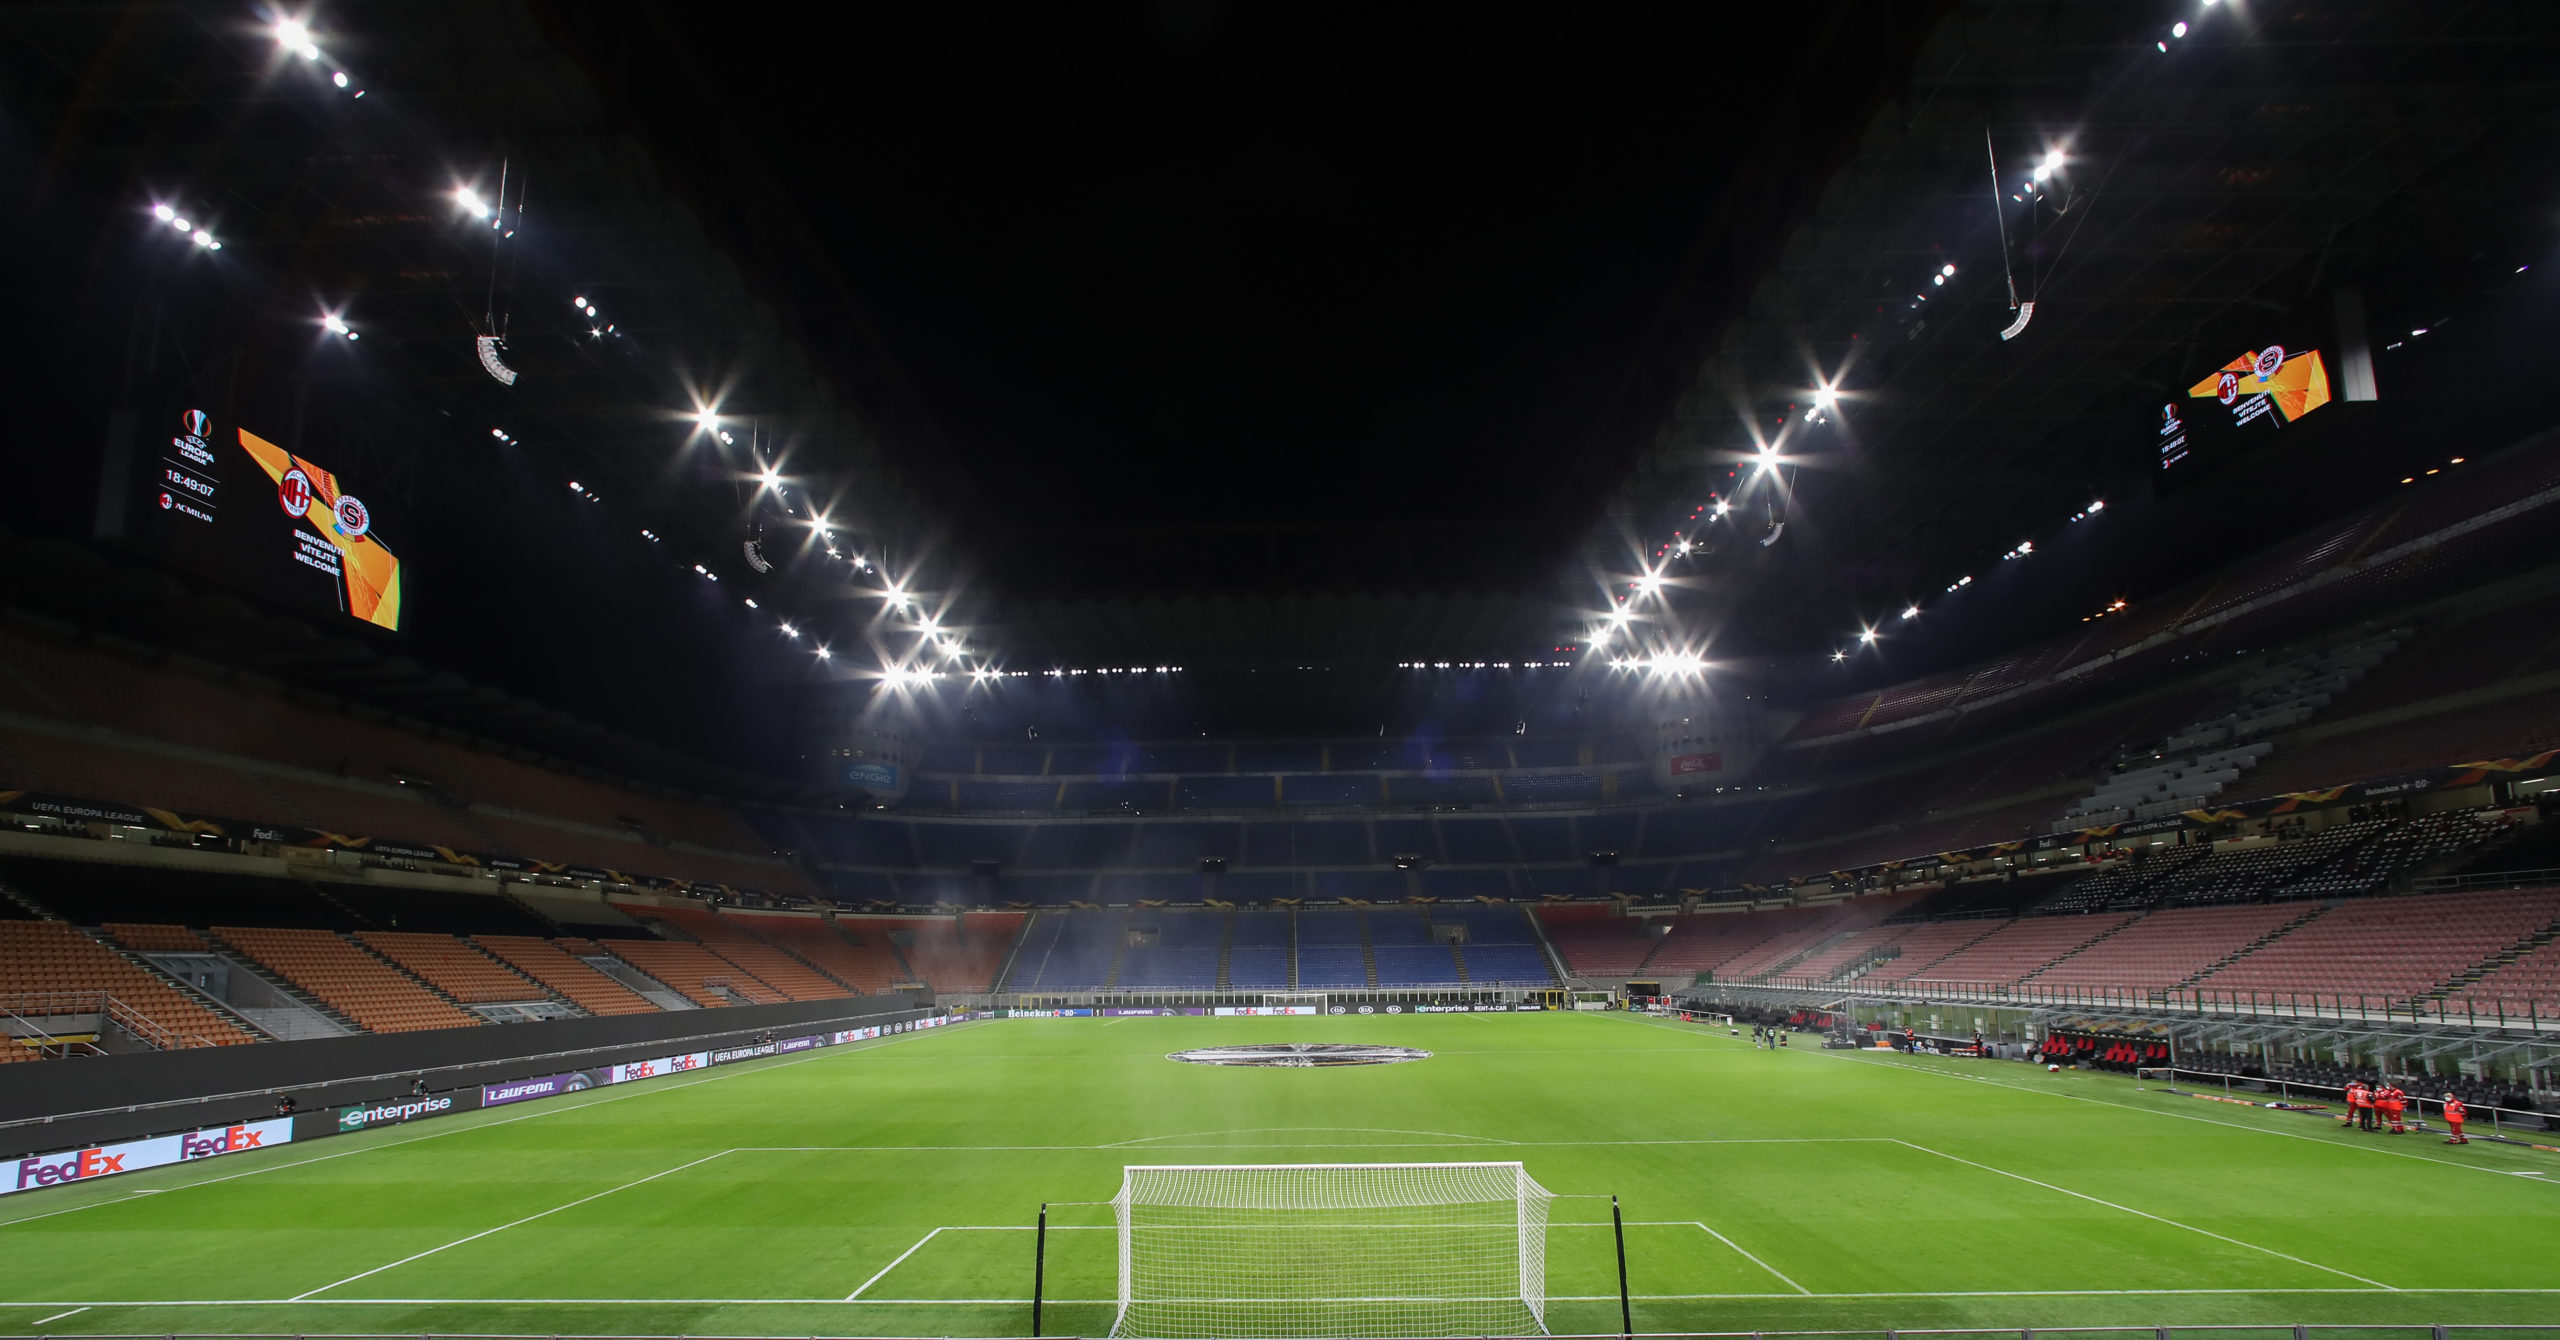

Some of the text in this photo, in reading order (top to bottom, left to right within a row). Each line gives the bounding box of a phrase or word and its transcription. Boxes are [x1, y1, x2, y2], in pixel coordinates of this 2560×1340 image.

[2236, 403, 2272, 427] WELCOME
[173, 437, 214, 463] EUROPA
[179, 449, 207, 466] LEAGUE
[166, 469, 215, 497] 18:49:07
[293, 528, 345, 557] BENVENUTI
[293, 551, 341, 577] WELCOME
[32, 802, 143, 823] UEFA EUROPA LEAGUE
[1008, 1009, 1053, 1018] Heineken
[1235, 1007, 1257, 1015] FedEx
[1273, 1006, 1295, 1015] FedEx
[1417, 1004, 1469, 1014] enterprise
[671, 1055, 698, 1073] FedEx
[715, 1044, 776, 1063] UEFA EUROPA LEAGUE
[625, 1062, 655, 1081] FedEx
[339, 1097, 453, 1126] enterprise
[181, 1126, 263, 1160] FedEx
[17, 1147, 125, 1190] FedEx
